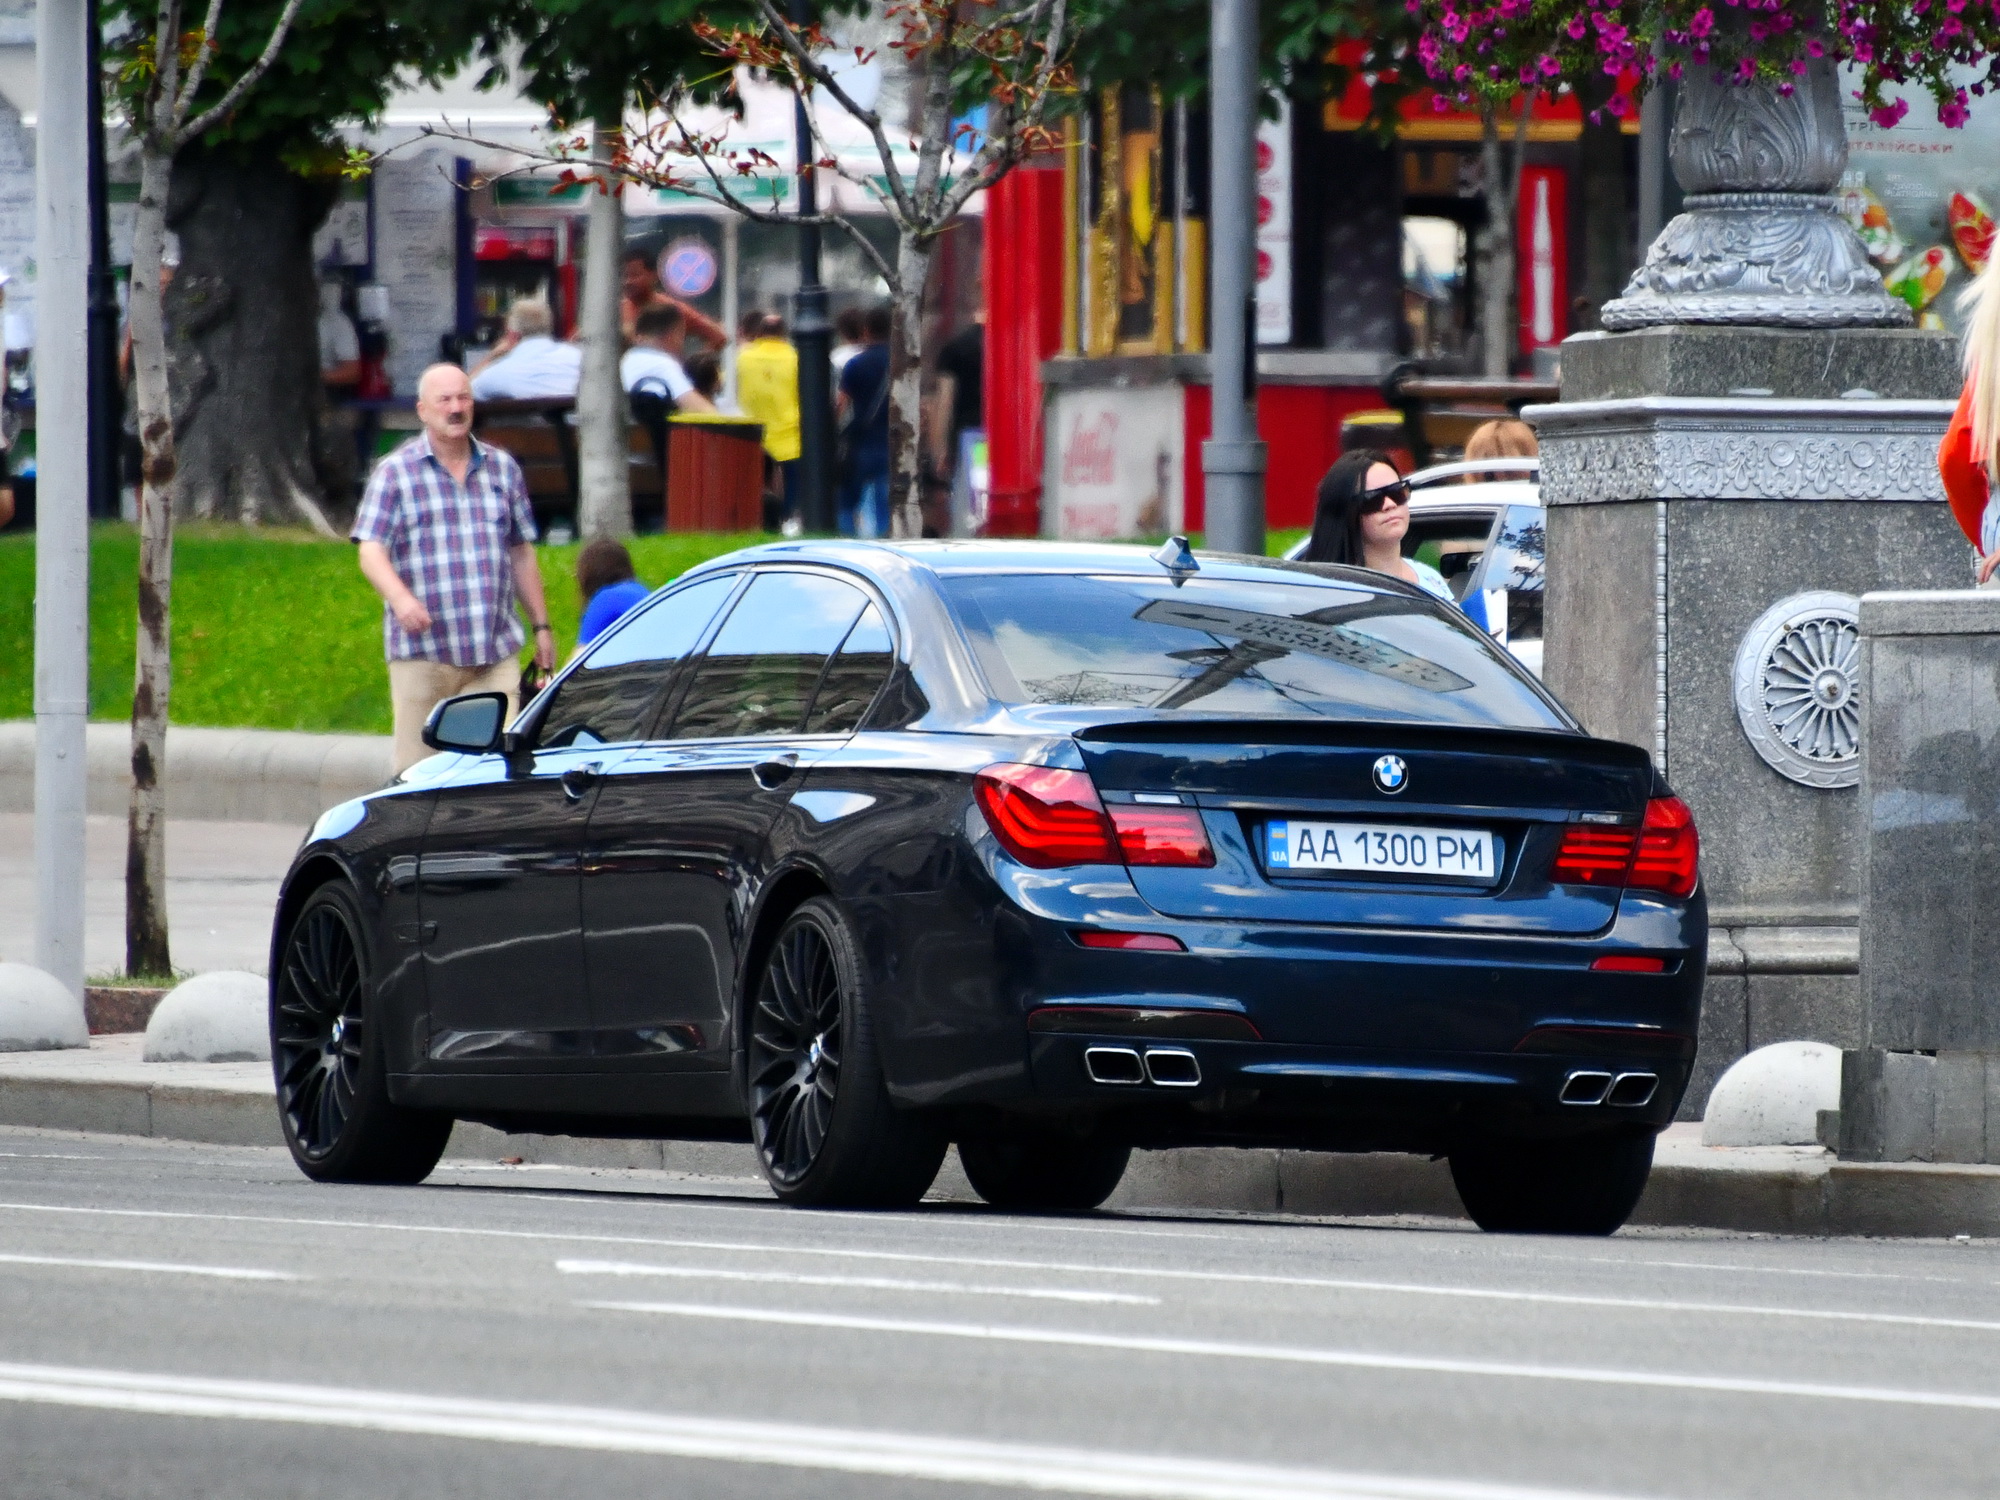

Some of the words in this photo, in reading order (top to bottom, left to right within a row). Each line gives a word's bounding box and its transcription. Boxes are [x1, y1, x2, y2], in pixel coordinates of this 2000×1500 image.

[1271, 850, 1287, 862] UA
[1296, 828, 1343, 863] AA
[1354, 831, 1427, 867] 1300
[1436, 835, 1483, 872] PM
